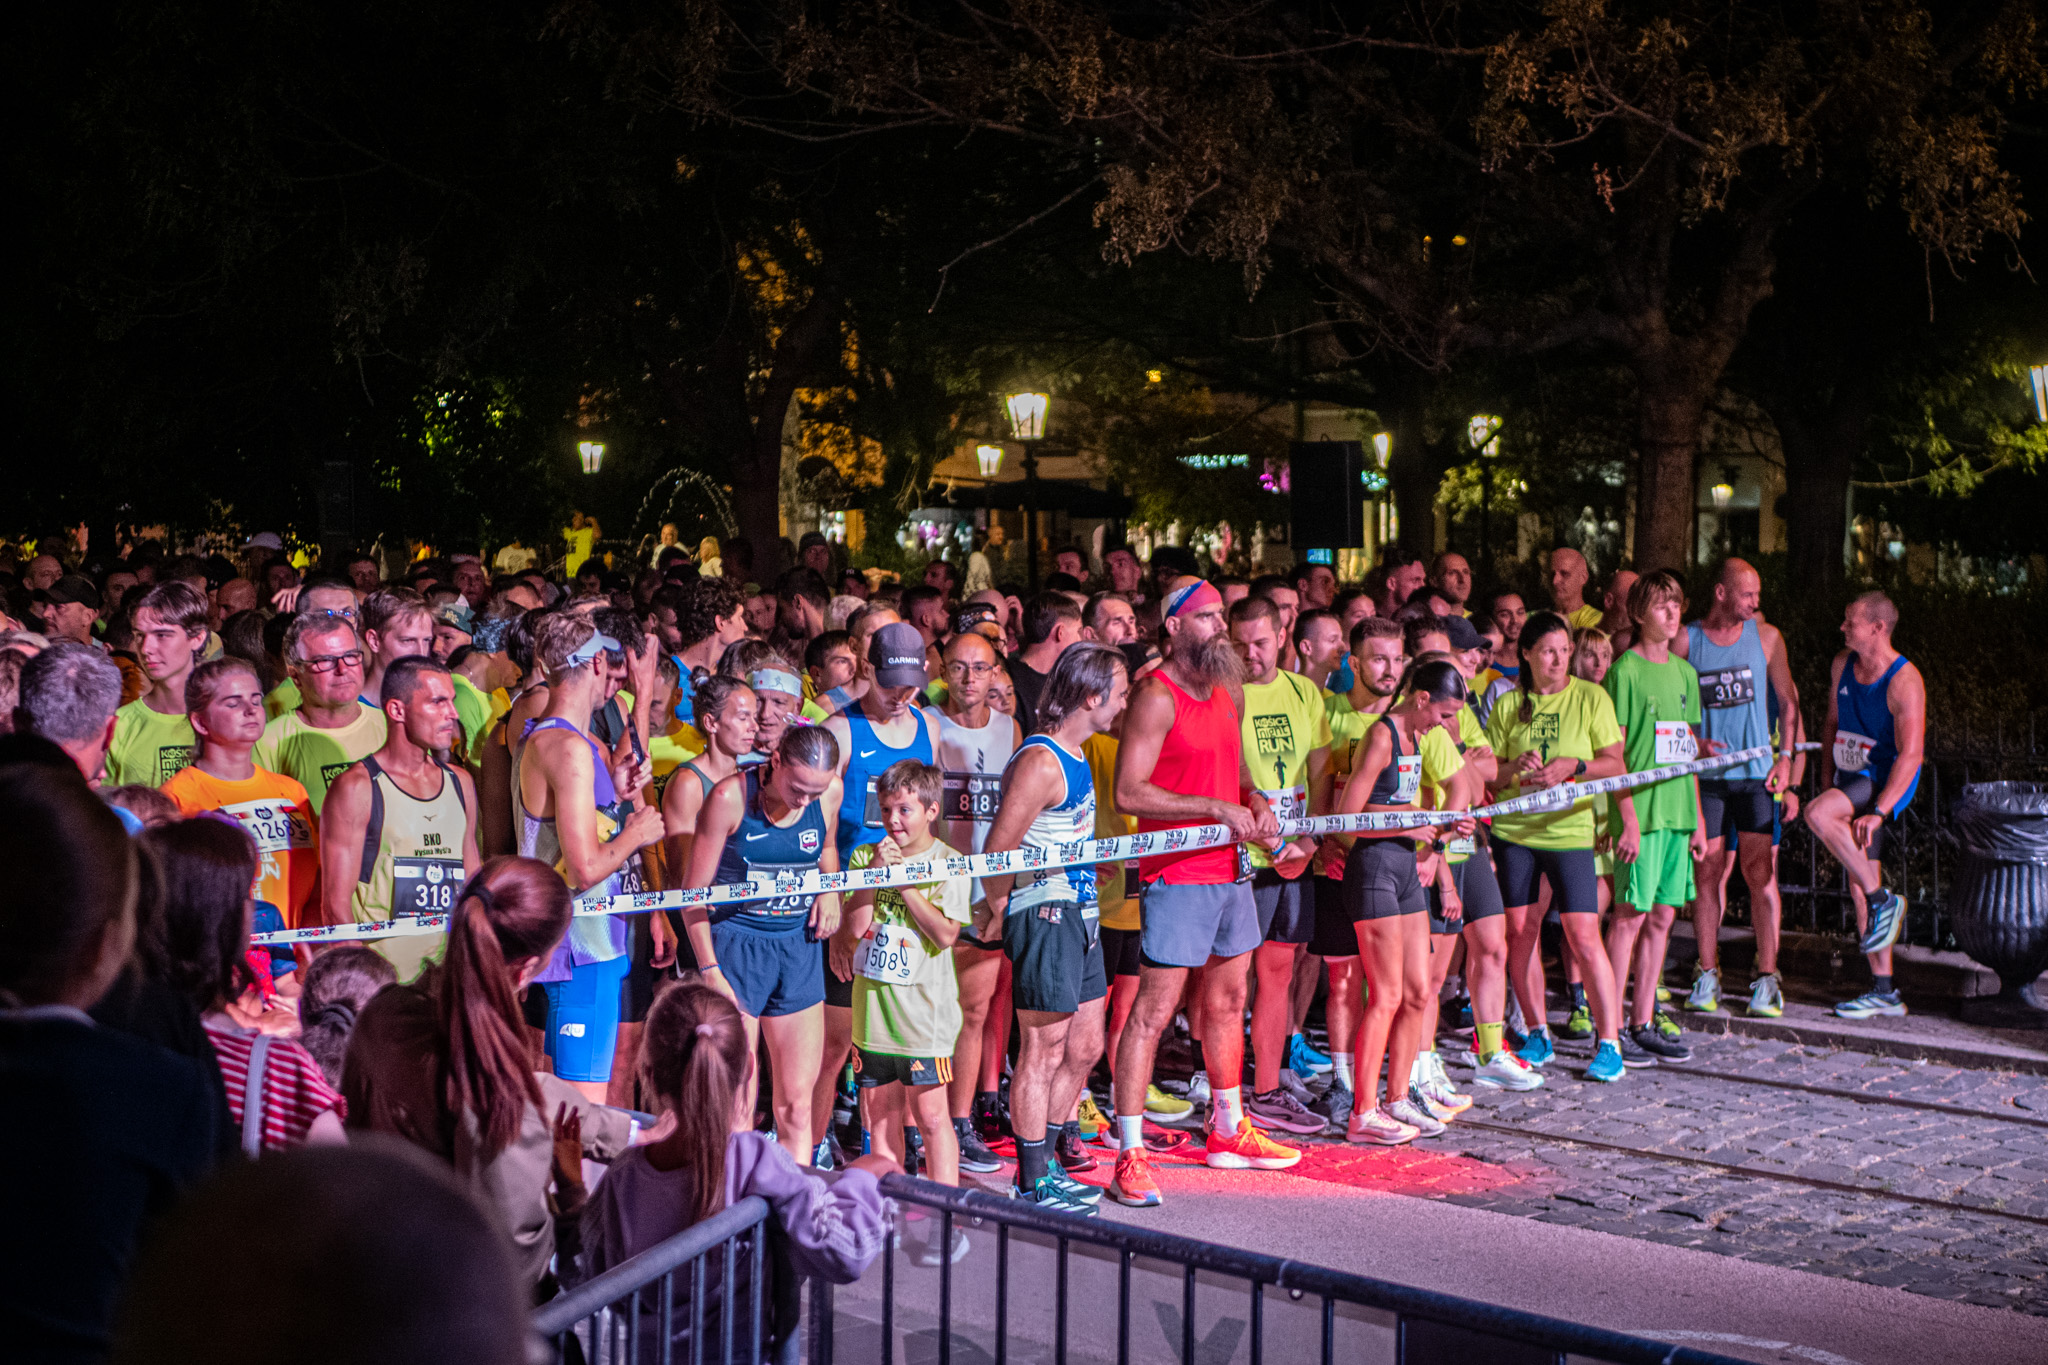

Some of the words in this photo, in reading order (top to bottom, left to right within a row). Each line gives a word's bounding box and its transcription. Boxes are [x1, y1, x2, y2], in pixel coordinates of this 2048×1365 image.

[887, 656, 920, 665] GARMIN
[1715, 682, 1742, 700] 319
[1254, 715, 1289, 728] KOŠICE
[1531, 727, 1559, 739] RUN
[1258, 736, 1294, 754] RUN
[1668, 740, 1691, 755] 1740
[160, 747, 193, 759] KOŠIC
[959, 794, 990, 812] 818
[1325, 816, 1341, 824] RUN
[1355, 814, 1370, 822] RUN
[1295, 819, 1311, 827] RUN
[252, 820, 296, 840] 1268
[1165, 829, 1183, 838] RUN
[1199, 825, 1217, 834] RUN
[423, 832, 442, 847] BKO
[1096, 838, 1114, 846] RUN
[1131, 833, 1149, 842] RUN
[623, 874, 640, 894] 48
[864, 876, 885, 885] KOŠICE
[775, 885, 797, 894] KOŠICE
[820, 881, 841, 890] KOŠICE
[415, 884, 452, 908] 318
[681, 895, 704, 903] KOŠICE
[729, 890, 751, 899] KOŠICE
[583, 903, 607, 913] KOŠICE
[633, 899, 656, 908] KOŠICE
[416, 918, 443, 927] KOŠICE
[357, 923, 386, 932] KOŠICE
[297, 929, 325, 938] KOŠICE
[864, 946, 899, 971] 1508
